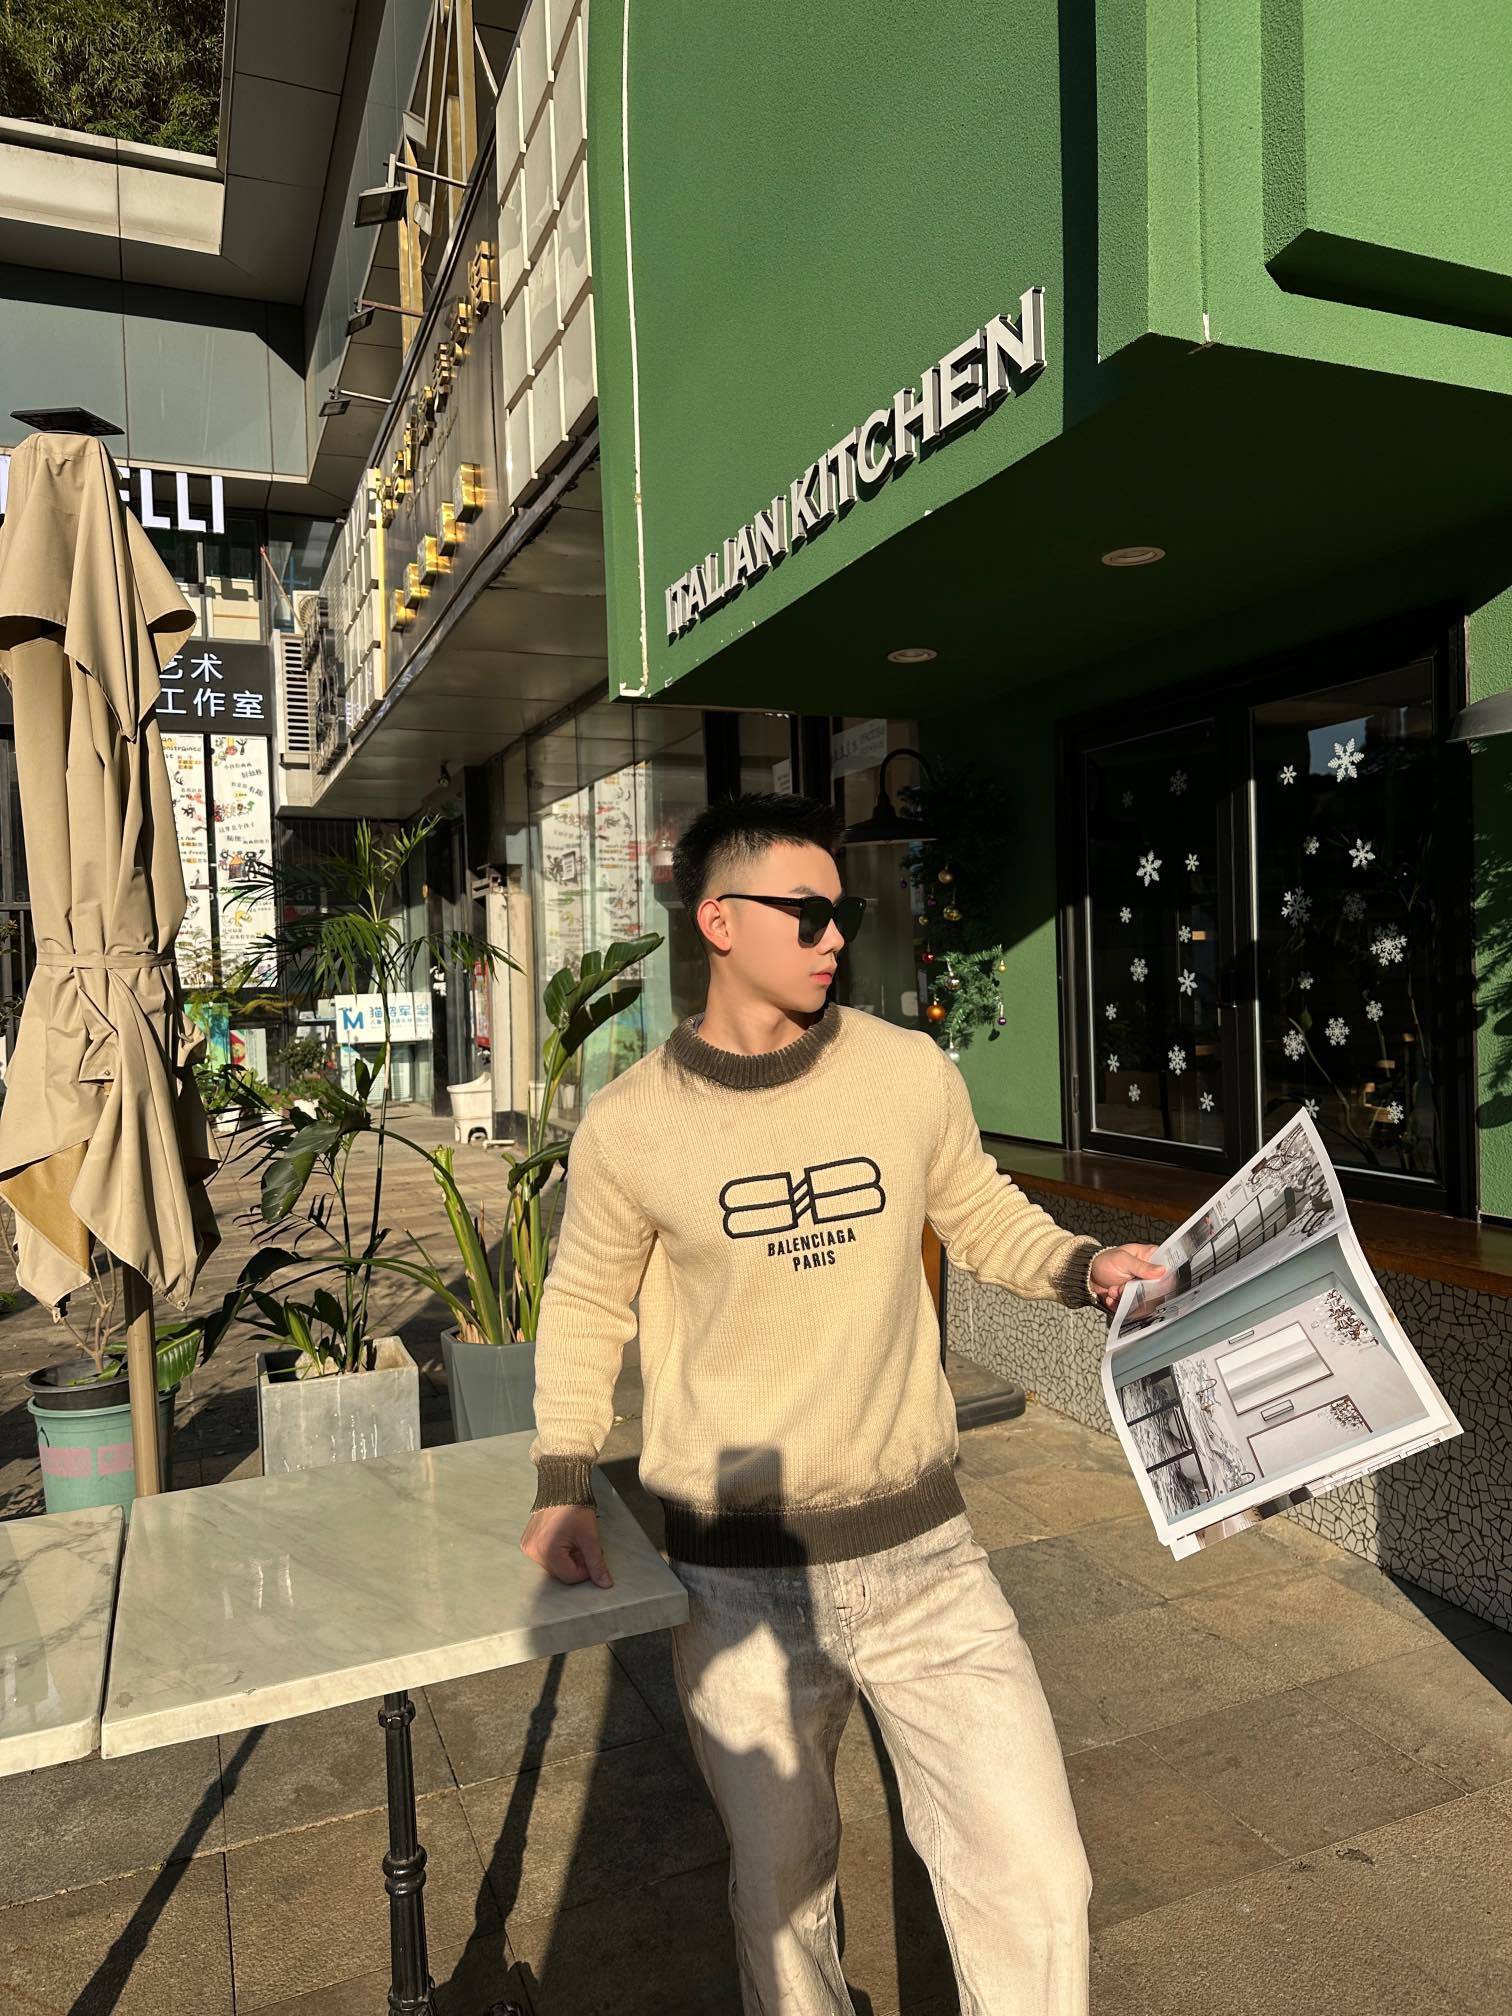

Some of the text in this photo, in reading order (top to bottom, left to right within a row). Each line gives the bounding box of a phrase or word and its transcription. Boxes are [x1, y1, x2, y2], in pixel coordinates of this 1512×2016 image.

[666, 286, 1047, 636] ITALIAN KITCHEN
[156, 688, 265, 719] 工作室
[767, 1228, 856, 1257] BALENCIAGA
[793, 1250, 836, 1271] PARIS
